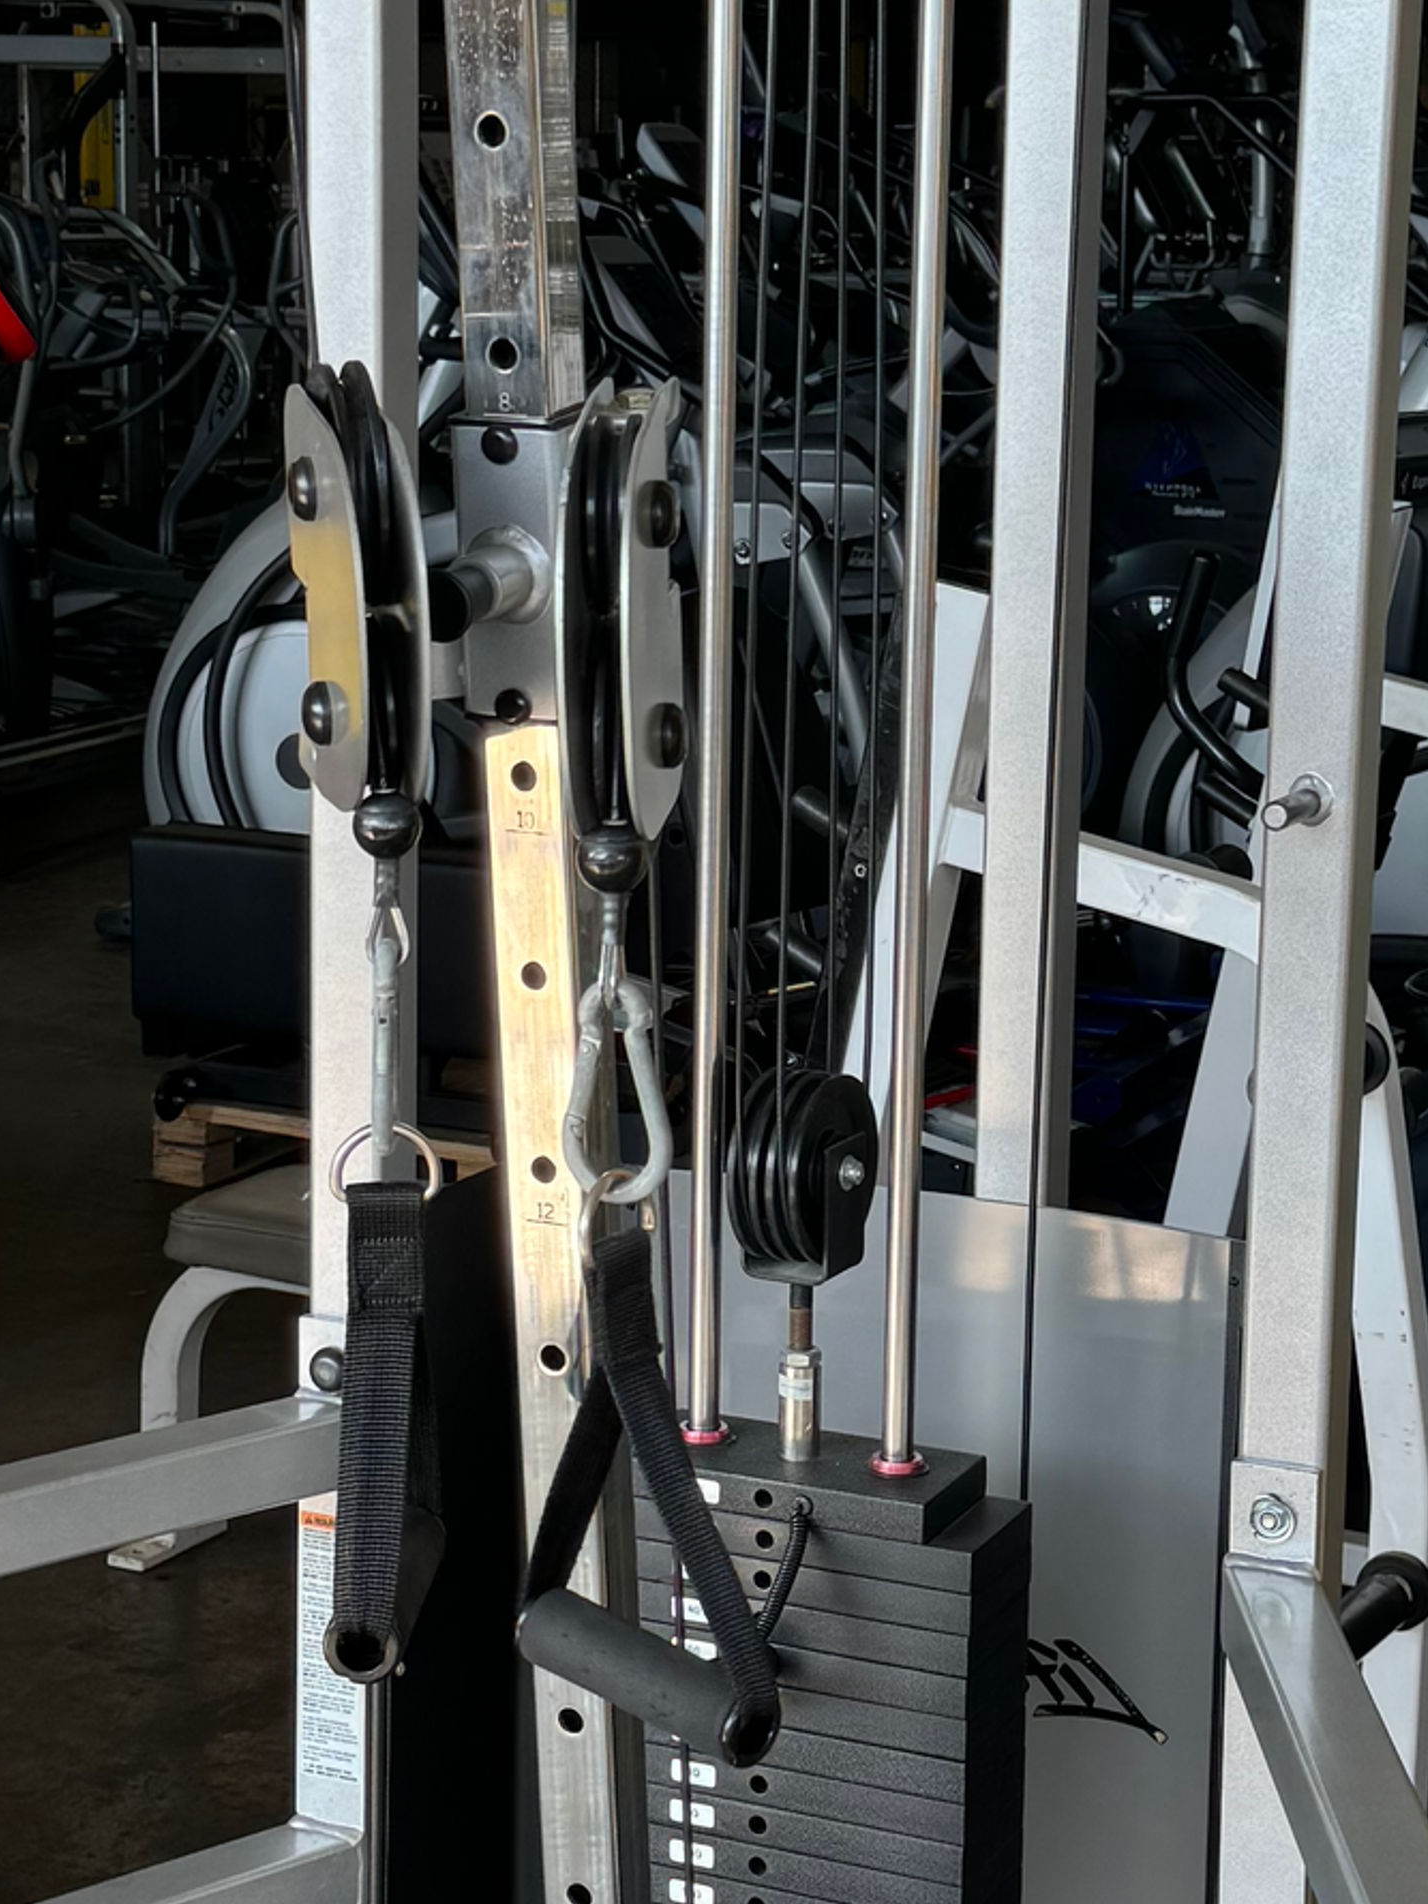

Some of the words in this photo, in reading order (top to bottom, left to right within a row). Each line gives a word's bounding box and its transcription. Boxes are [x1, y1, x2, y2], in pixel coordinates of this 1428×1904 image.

[498, 392, 511, 413] 8
[515, 810, 535, 830] 10
[536, 1201, 555, 1220] 12
